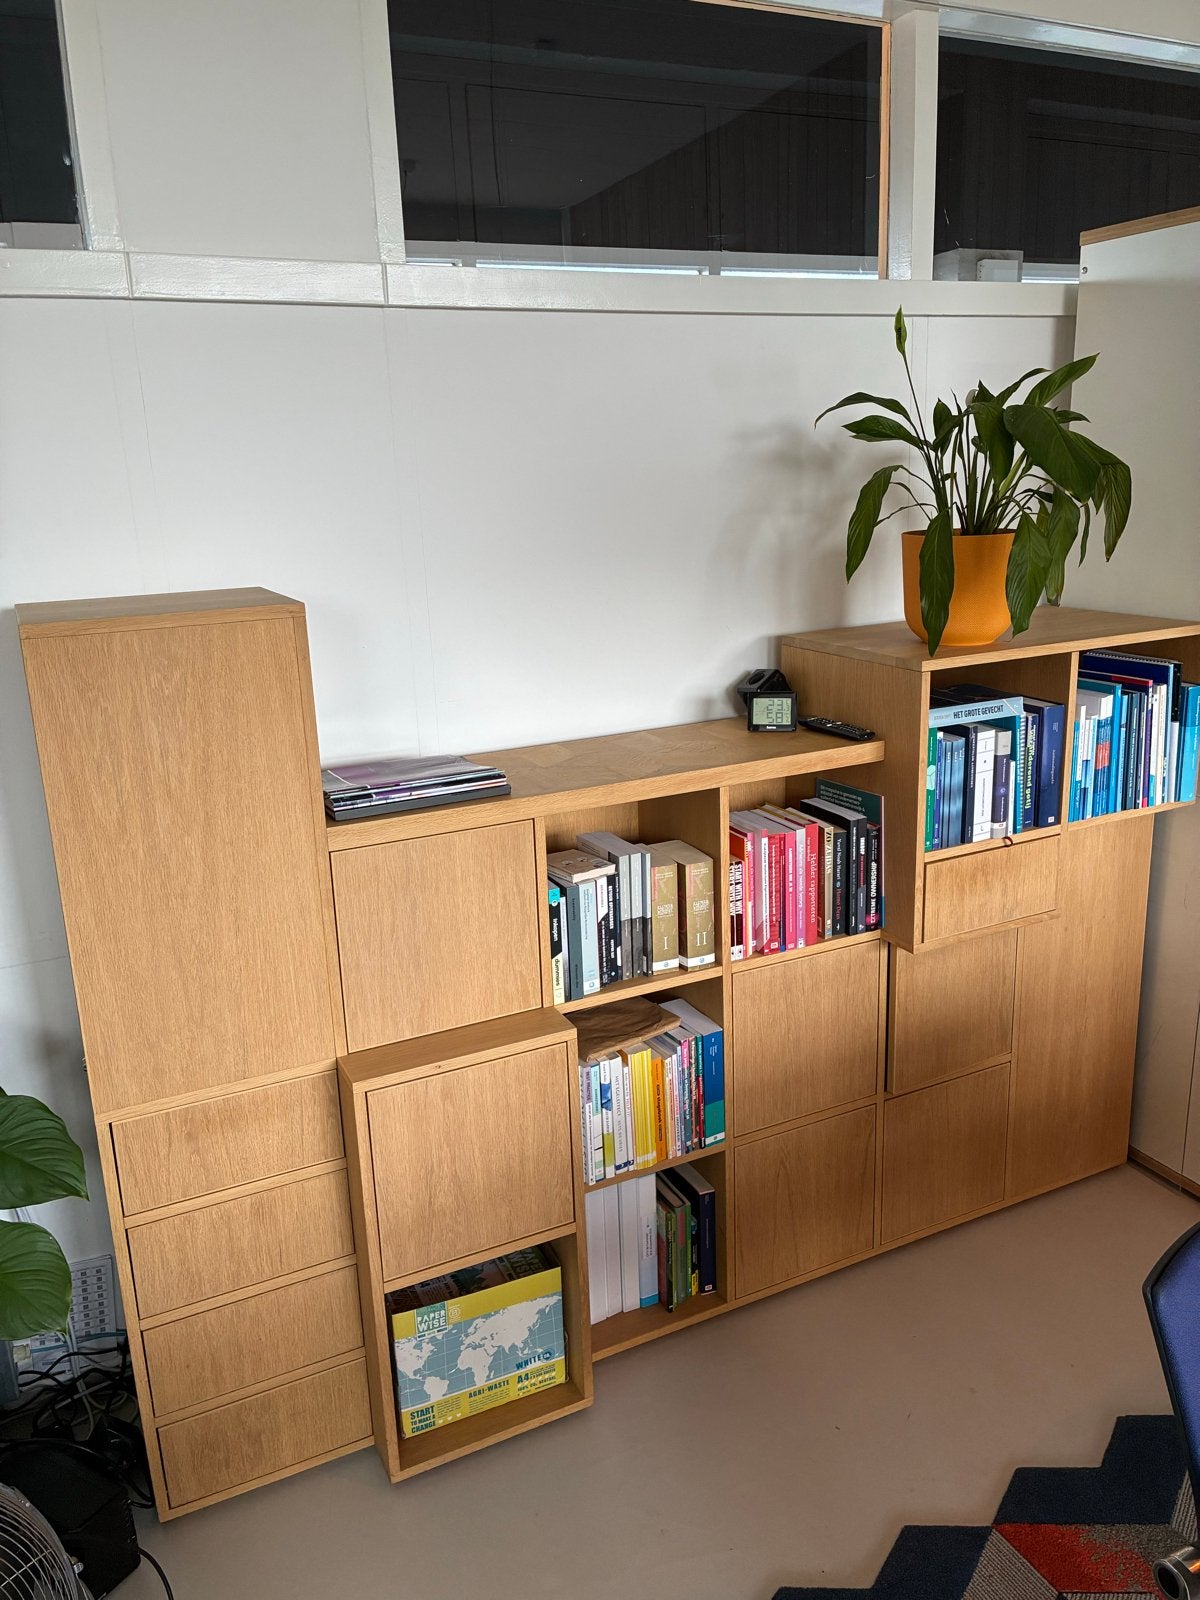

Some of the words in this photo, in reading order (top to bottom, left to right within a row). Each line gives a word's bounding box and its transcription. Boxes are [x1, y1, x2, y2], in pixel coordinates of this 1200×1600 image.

[954, 710, 963, 719] HET
[964, 708, 981, 717] GROTE
[982, 705, 1004, 715] GEVECHT
[826, 832, 832, 842] ZO
[696, 932, 707, 946] II
[417, 1310, 445, 1324] PAPER
[418, 1317, 445, 1332] WISE
[516, 1354, 541, 1370] WHITE
[518, 1373, 529, 1384] A4
[468, 1380, 509, 1398] AGRI-WASTE
[410, 1405, 435, 1420] START
[411, 1420, 436, 1433] CHANGE
